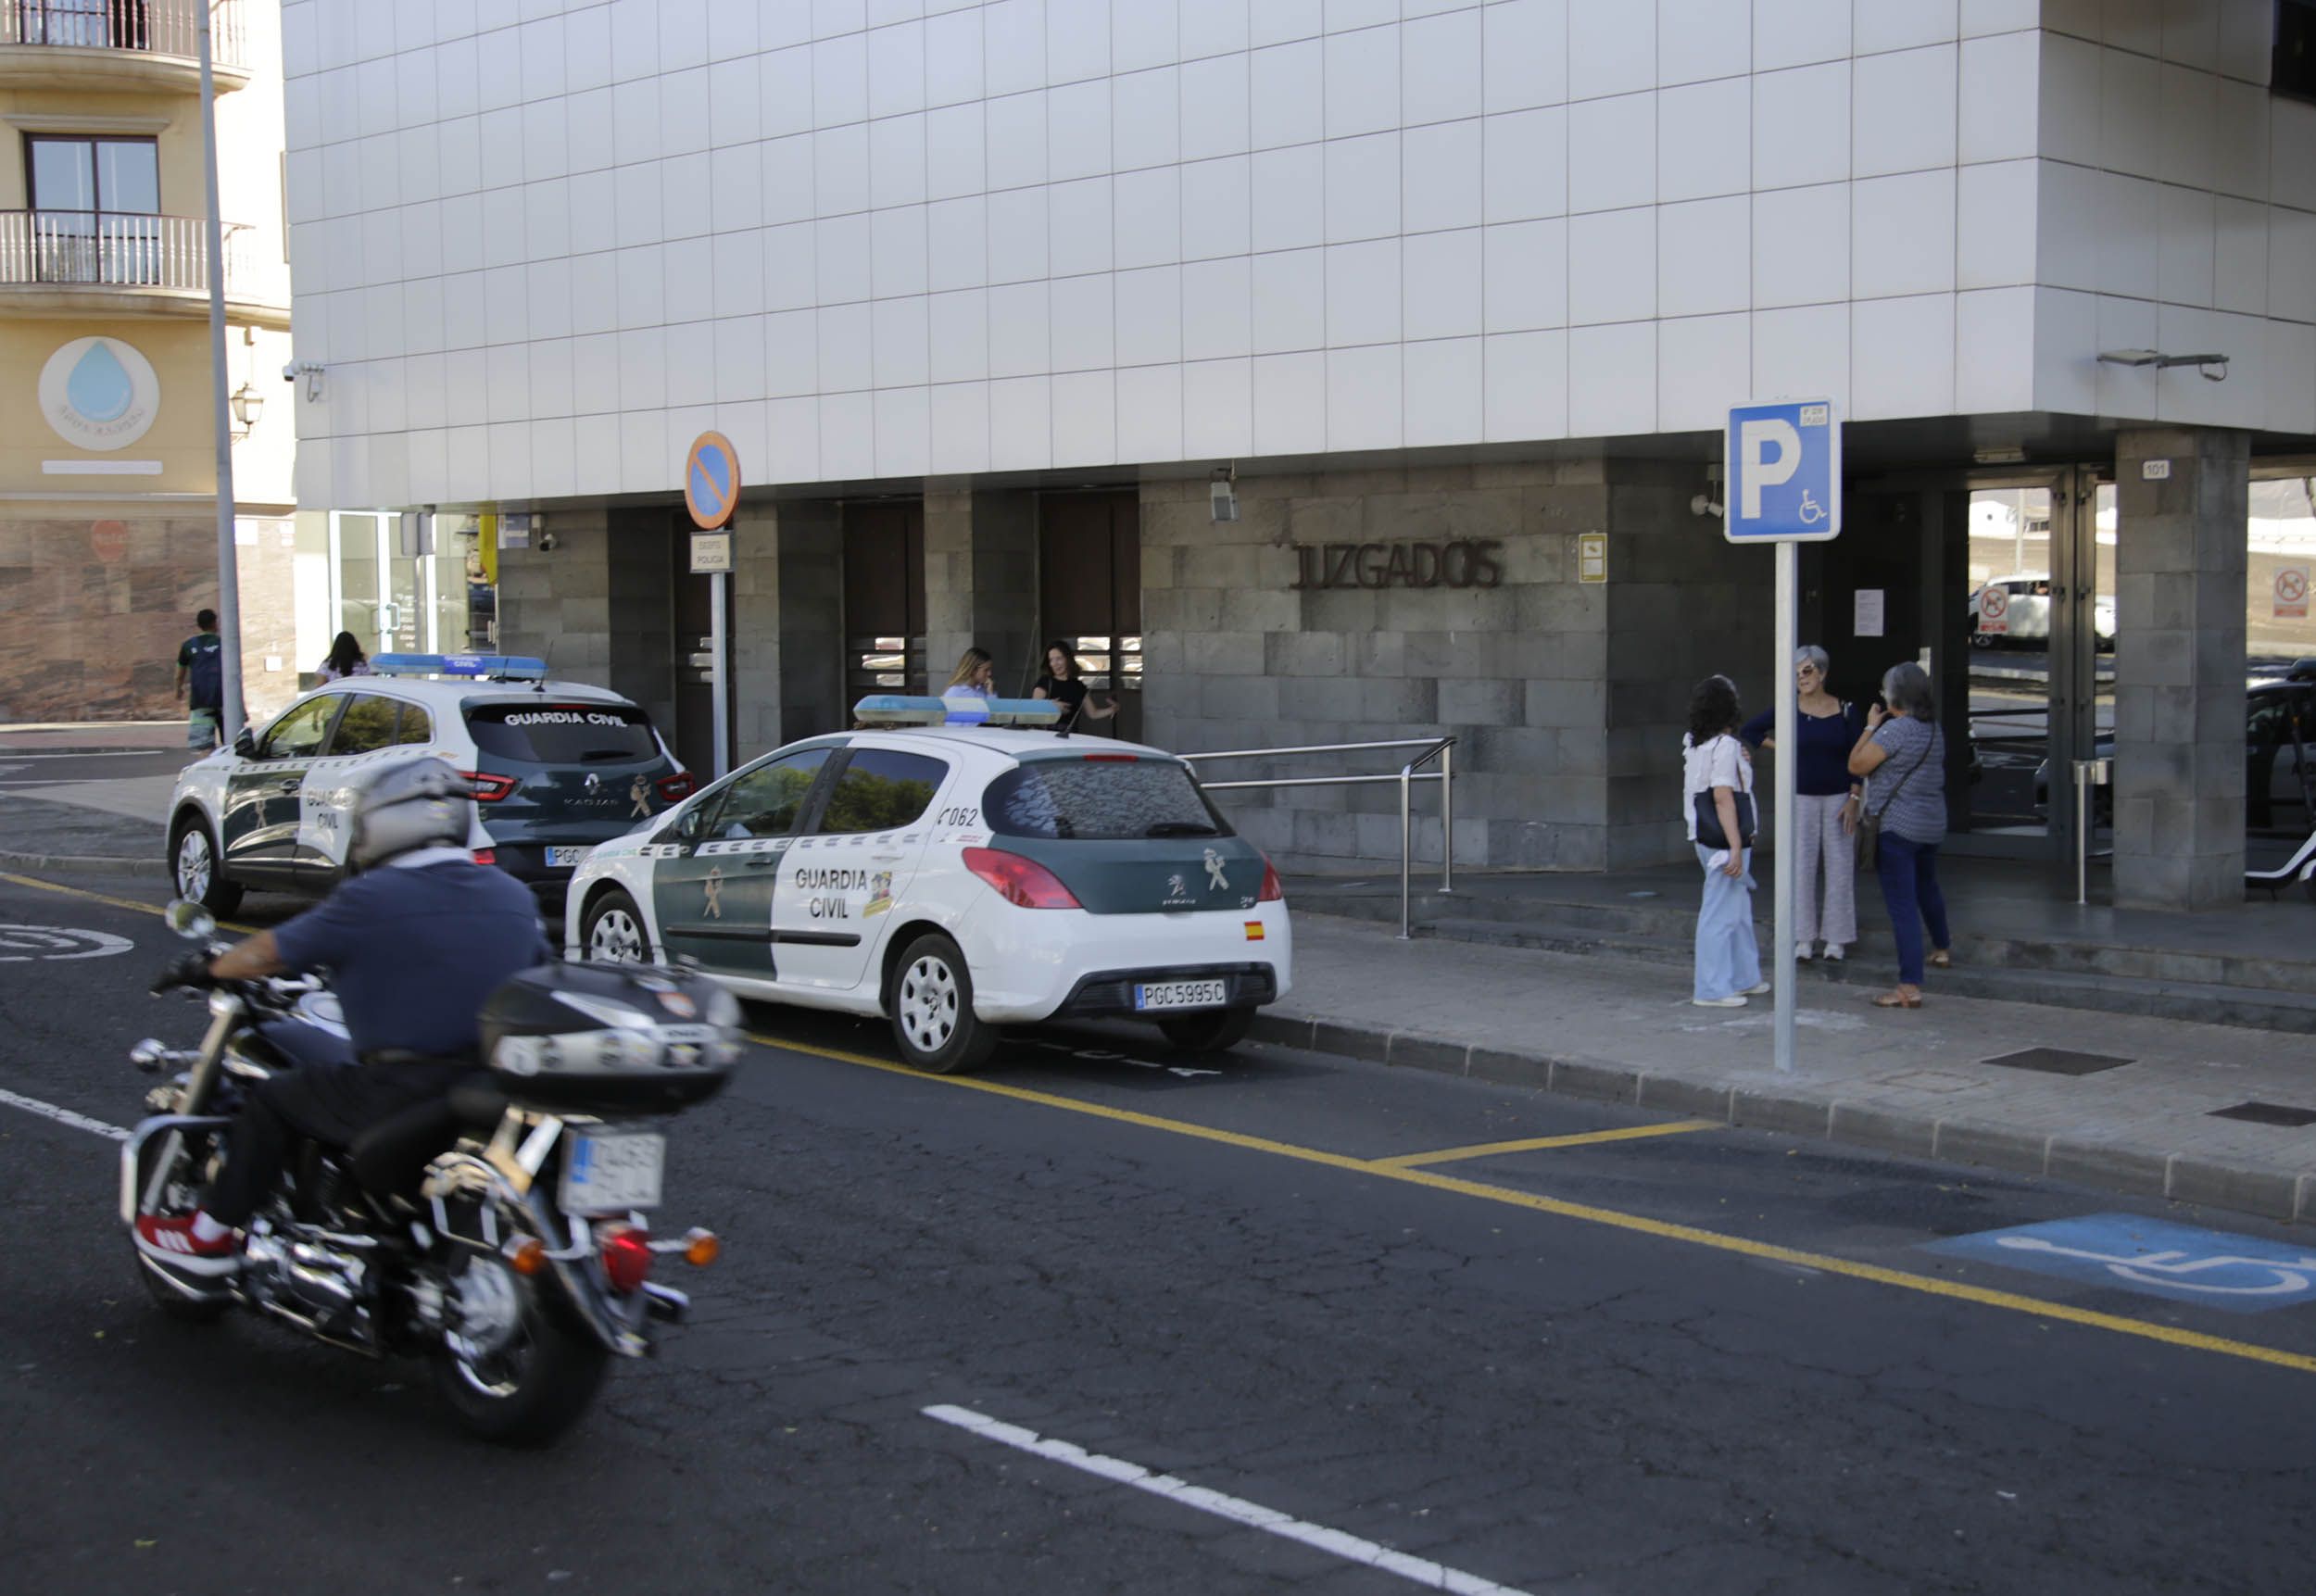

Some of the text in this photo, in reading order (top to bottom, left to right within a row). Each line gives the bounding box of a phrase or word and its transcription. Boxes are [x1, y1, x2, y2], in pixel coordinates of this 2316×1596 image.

[1742, 419, 1801, 519] P
[2146, 464, 2165, 475] 101
[1290, 540, 1503, 590] JUZGADOS
[504, 711, 628, 727] GUARDIA CIVIL
[948, 807, 978, 826] 062
[796, 868, 867, 889] GUARDIA
[810, 897, 849, 919] CIVIL
